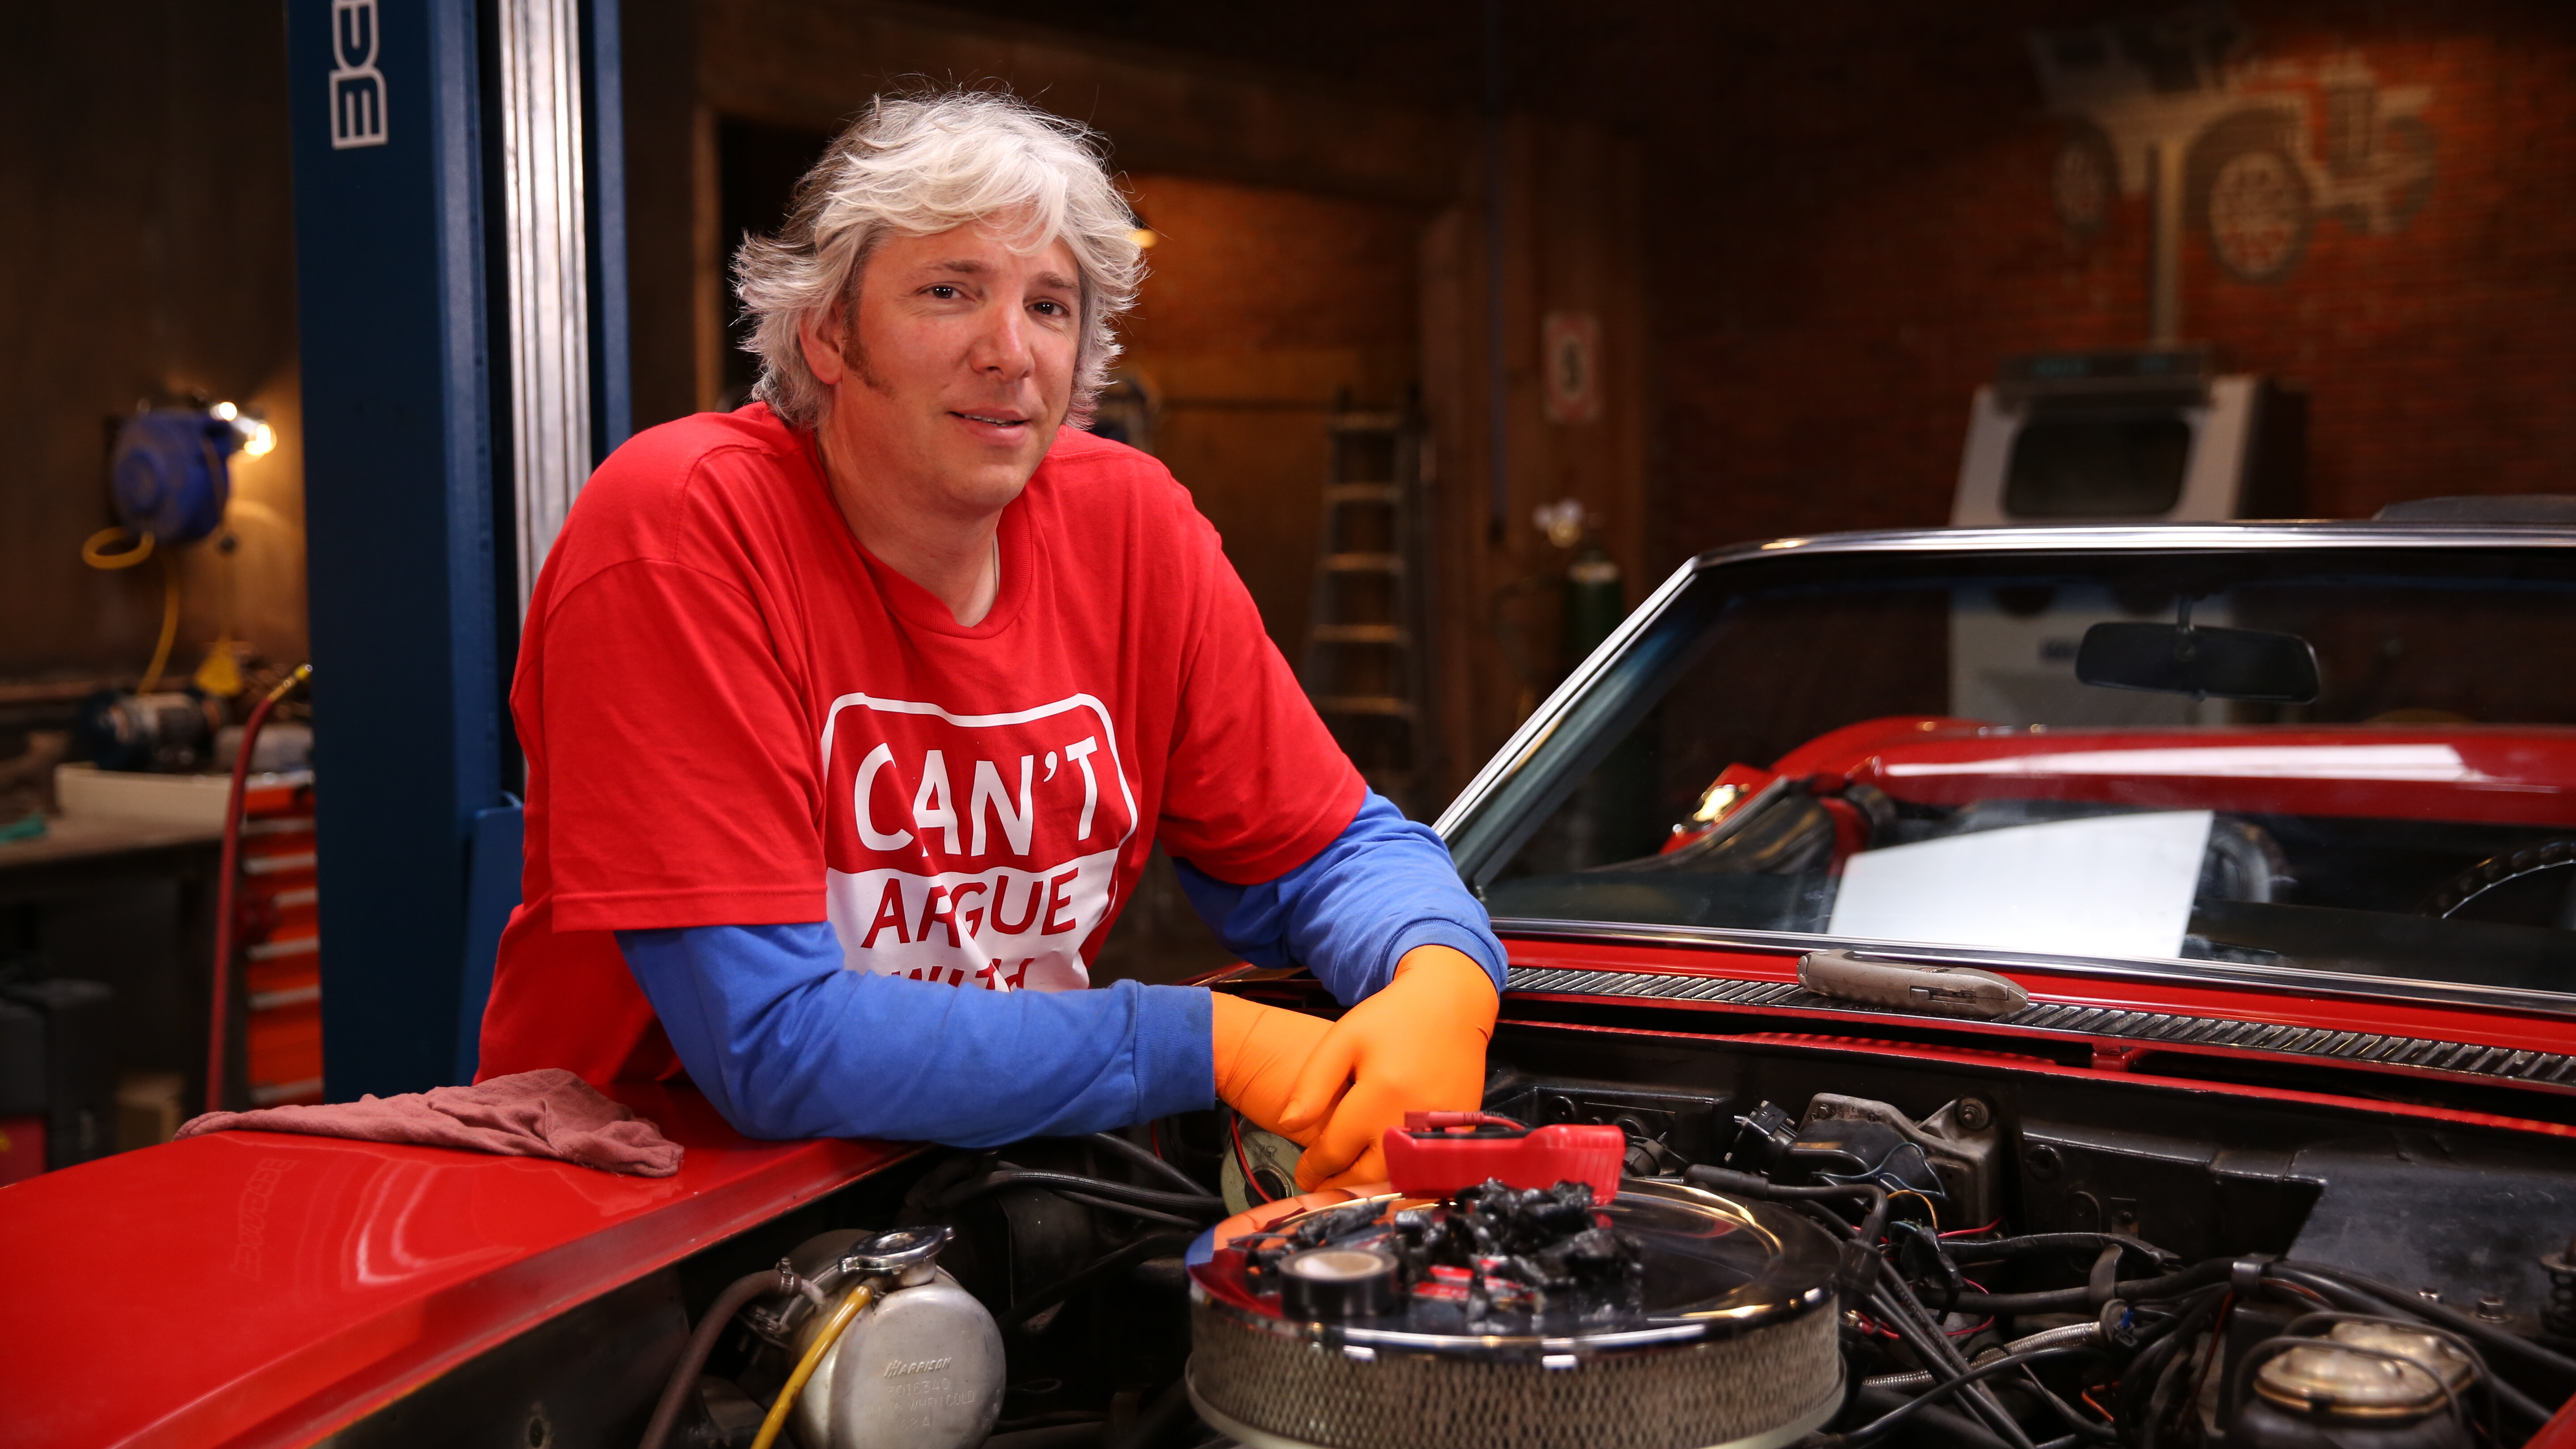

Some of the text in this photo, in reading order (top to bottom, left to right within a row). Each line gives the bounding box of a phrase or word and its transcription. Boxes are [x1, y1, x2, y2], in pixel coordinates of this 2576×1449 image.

[854, 736, 1098, 857] CAN'T
[860, 867, 1079, 949] ARGUE
[884, 1357, 951, 1378] HARRISON
[886, 1377, 950, 1398] 3016340
[946, 1390, 975, 1407] COLD
